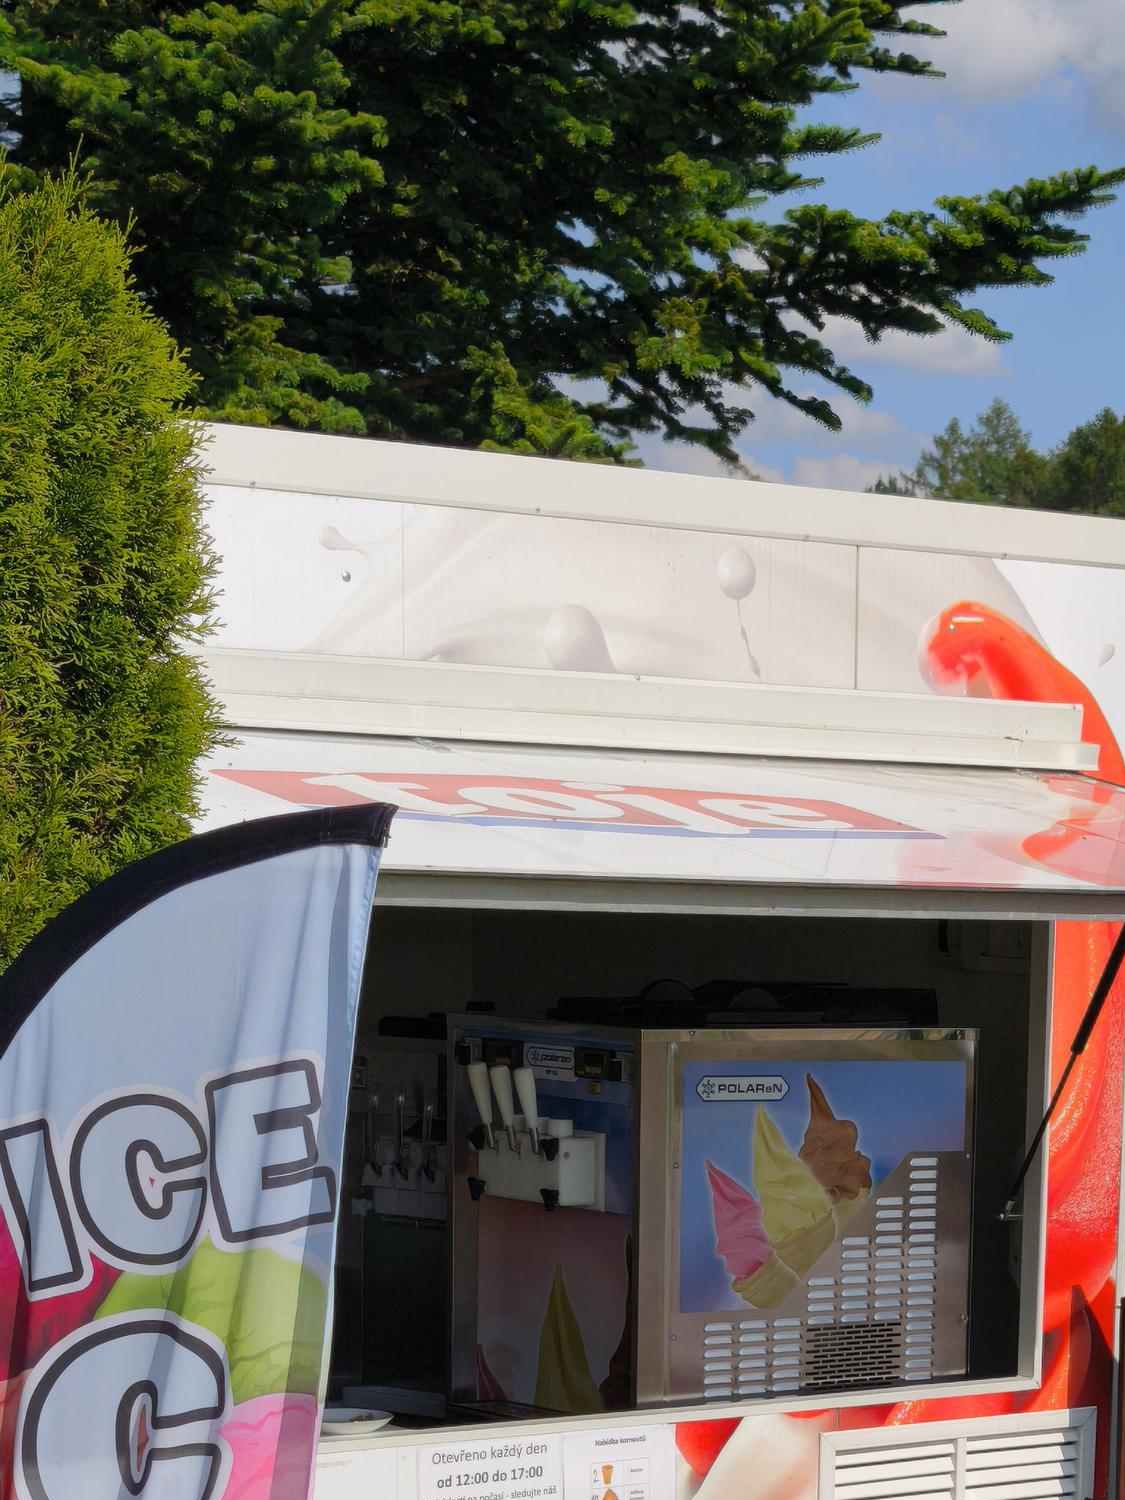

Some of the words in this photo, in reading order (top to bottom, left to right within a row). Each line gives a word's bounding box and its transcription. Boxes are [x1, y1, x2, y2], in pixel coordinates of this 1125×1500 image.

[0, 1059, 336, 1292] ICE
[432, 1449, 487, 1465] Otevřeno
[490, 1443, 522, 1459] každý
[526, 1442, 548, 1455] den
[437, 1475, 452, 1488] od
[456, 1471, 489, 1486] 12:00
[492, 1469, 507, 1482] do
[511, 1466, 544, 1480] 17:00
[510, 1488, 541, 1500] sledujte
[543, 1485, 557, 1496] náš
